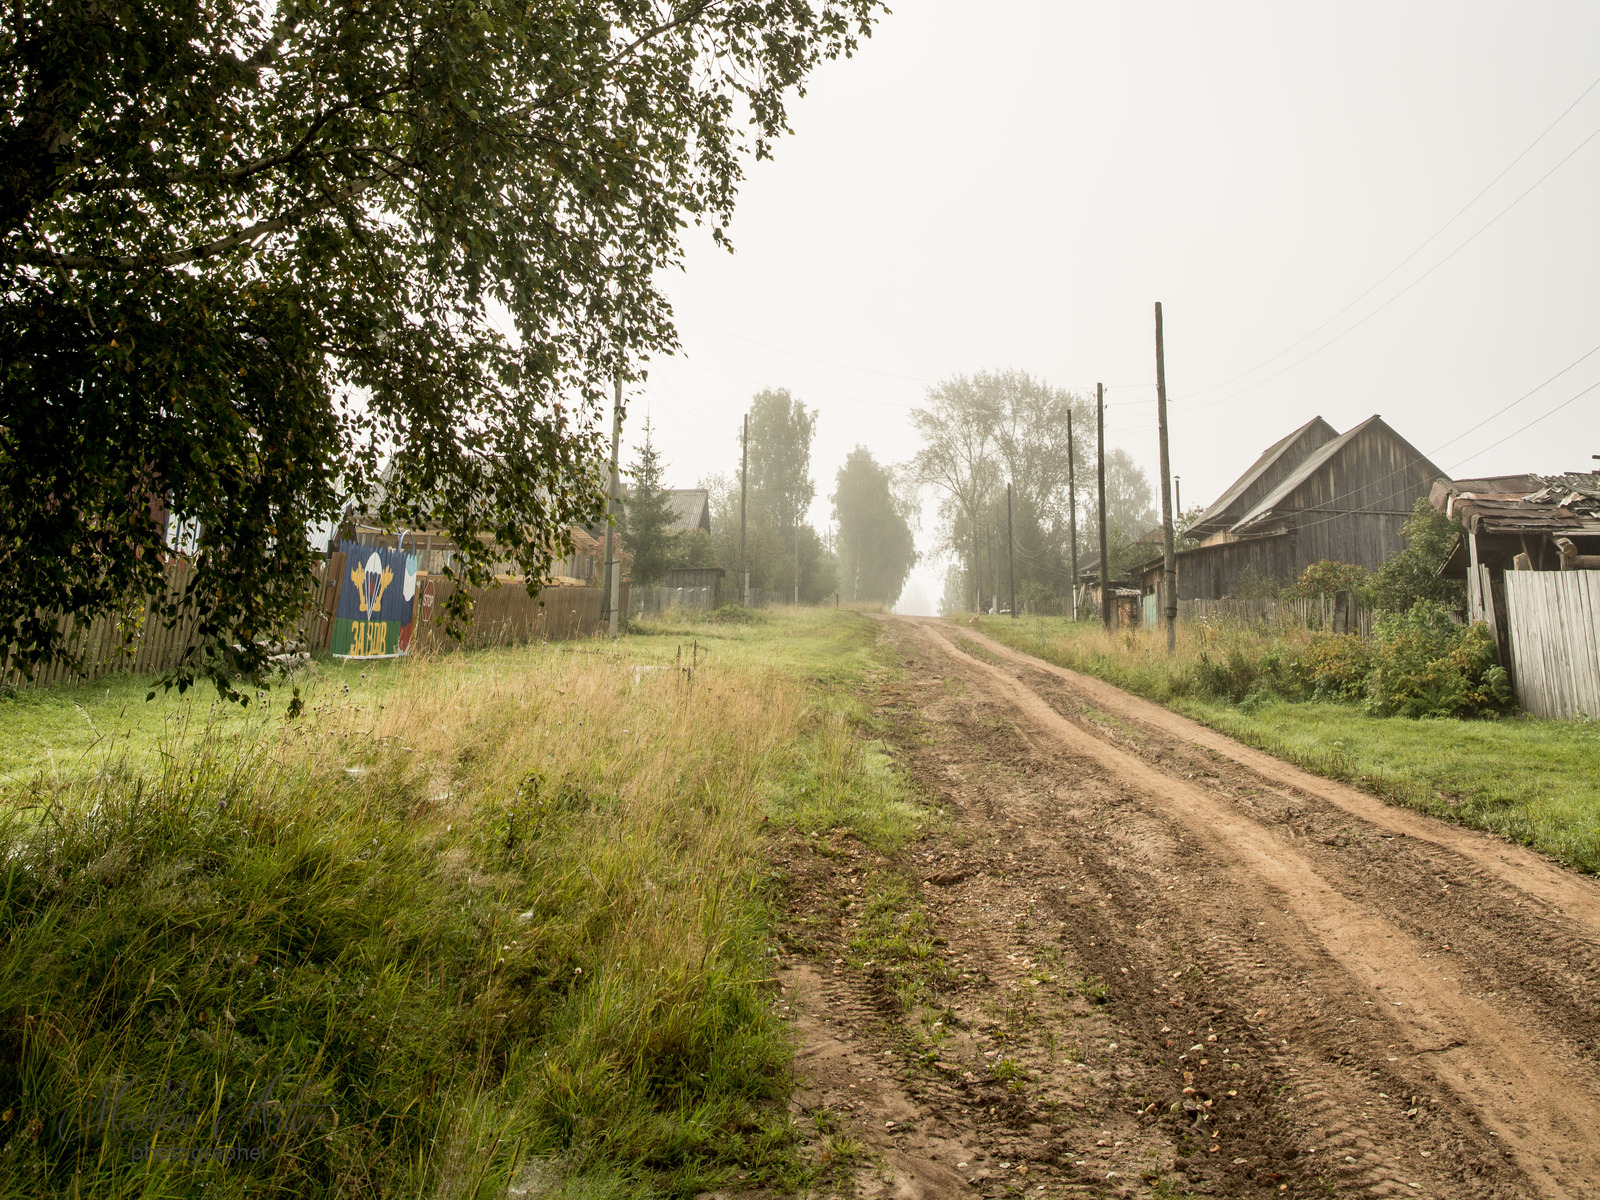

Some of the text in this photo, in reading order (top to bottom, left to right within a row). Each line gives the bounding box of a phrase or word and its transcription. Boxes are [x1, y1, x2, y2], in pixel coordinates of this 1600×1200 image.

[423, 593, 434, 607] STOP
[350, 621, 387, 656] ЗА ВДВ
